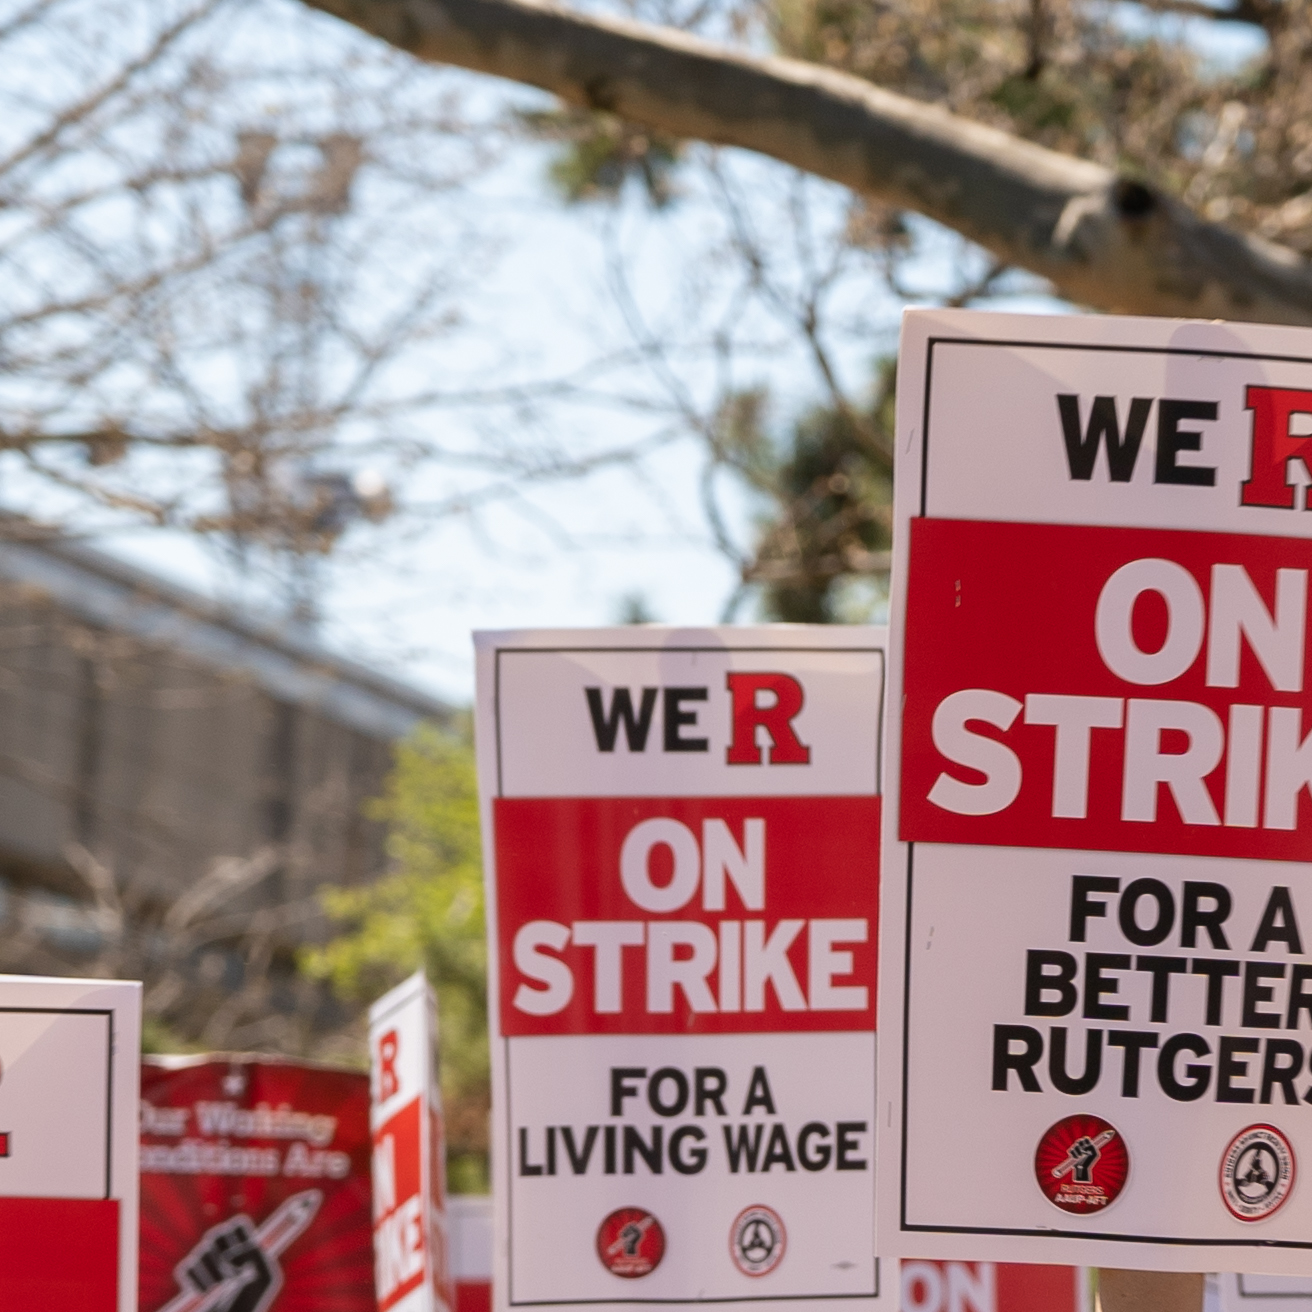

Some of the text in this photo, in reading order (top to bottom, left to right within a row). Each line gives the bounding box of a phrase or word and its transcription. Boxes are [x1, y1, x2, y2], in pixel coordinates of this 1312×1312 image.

[1055, 392, 1219, 488] WE
[1094, 556, 1309, 693] ON
[584, 670, 811, 766] WE R
[618, 816, 766, 913] ON
[1067, 873, 1305, 955] FOR A
[510, 917, 869, 1018] STRIKE
[609, 1065, 777, 1117] FOR A
[517, 1120, 869, 1178] LIVING WAGE
